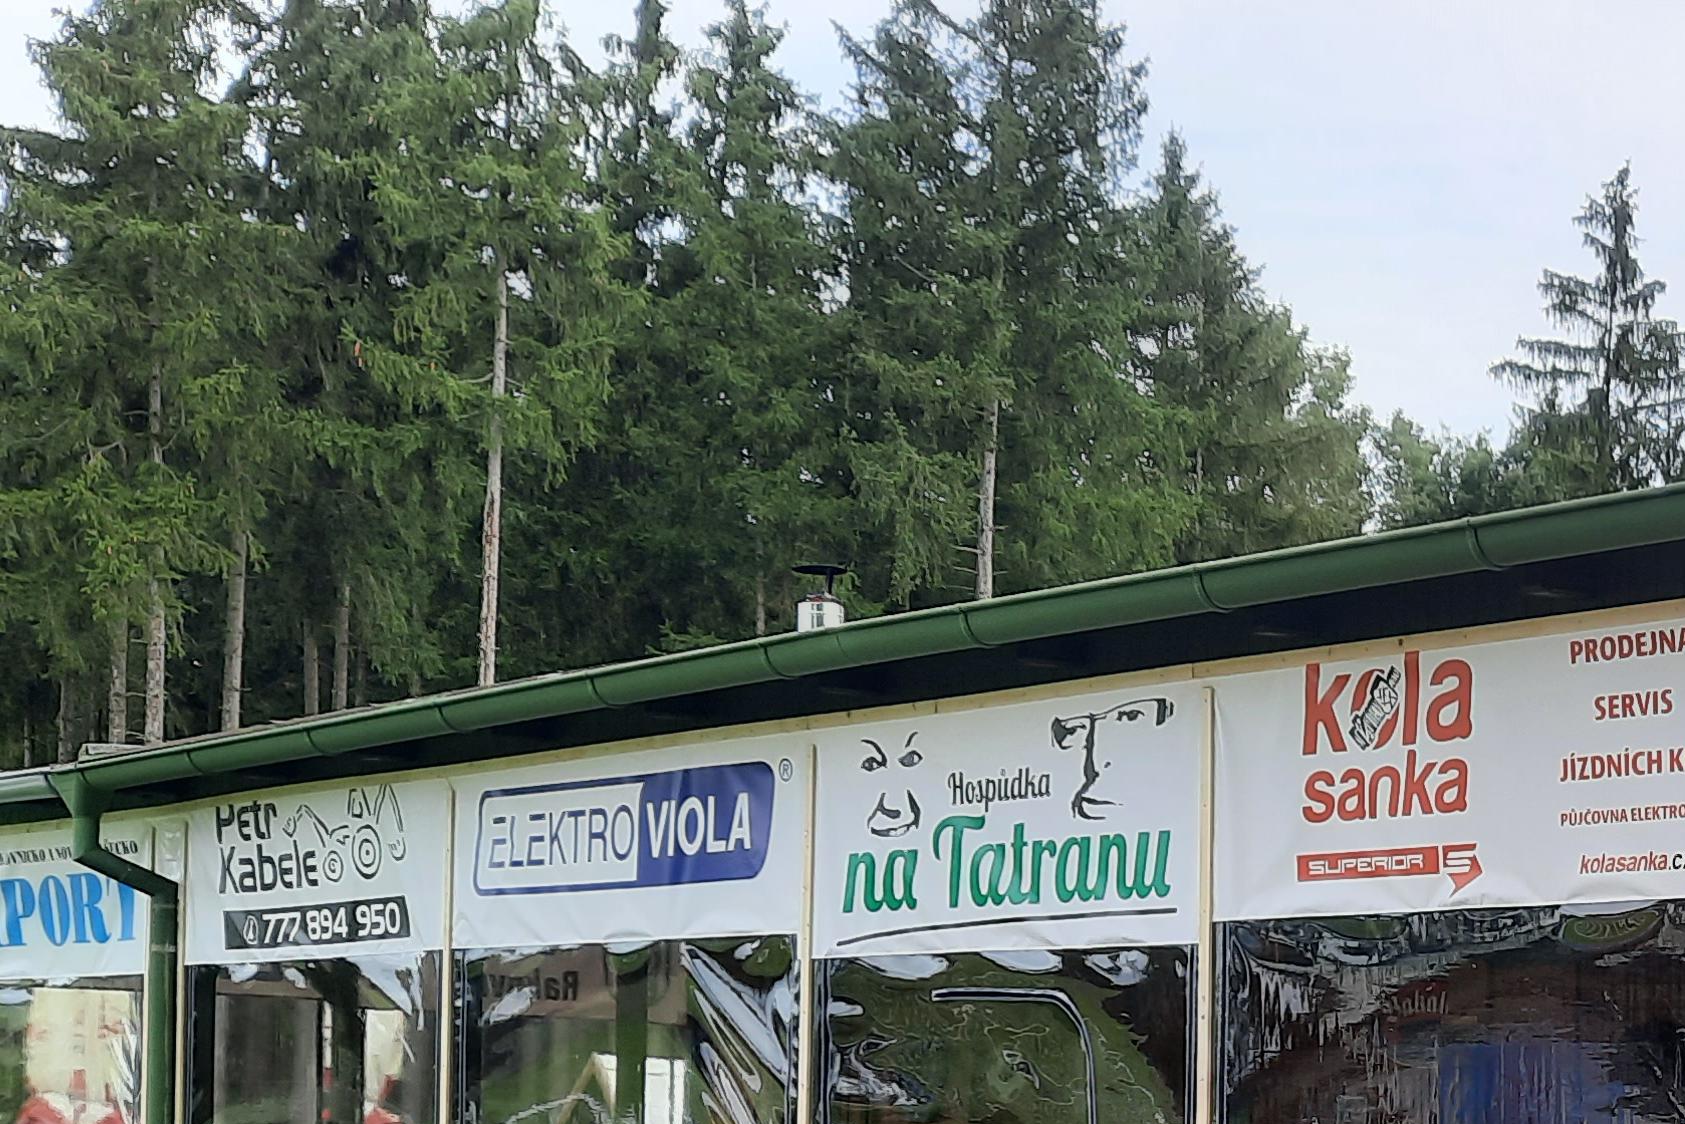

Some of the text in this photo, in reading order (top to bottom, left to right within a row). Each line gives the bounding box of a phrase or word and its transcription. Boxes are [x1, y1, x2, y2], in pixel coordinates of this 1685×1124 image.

[1301, 650, 1473, 756] kola
[1594, 689, 1673, 721] SERVIS
[1559, 747, 1662, 782] JÍZDNÍCH
[1301, 749, 1469, 824] sanka
[216, 800, 277, 844] Petr
[1560, 807, 1628, 827] PŮJČOVNA
[218, 839, 319, 894] Kabele
[842, 815, 1171, 914] na Tatranu
[1308, 853, 1424, 876] SUPERIOR
[262, 902, 400, 944] 777 894 950
